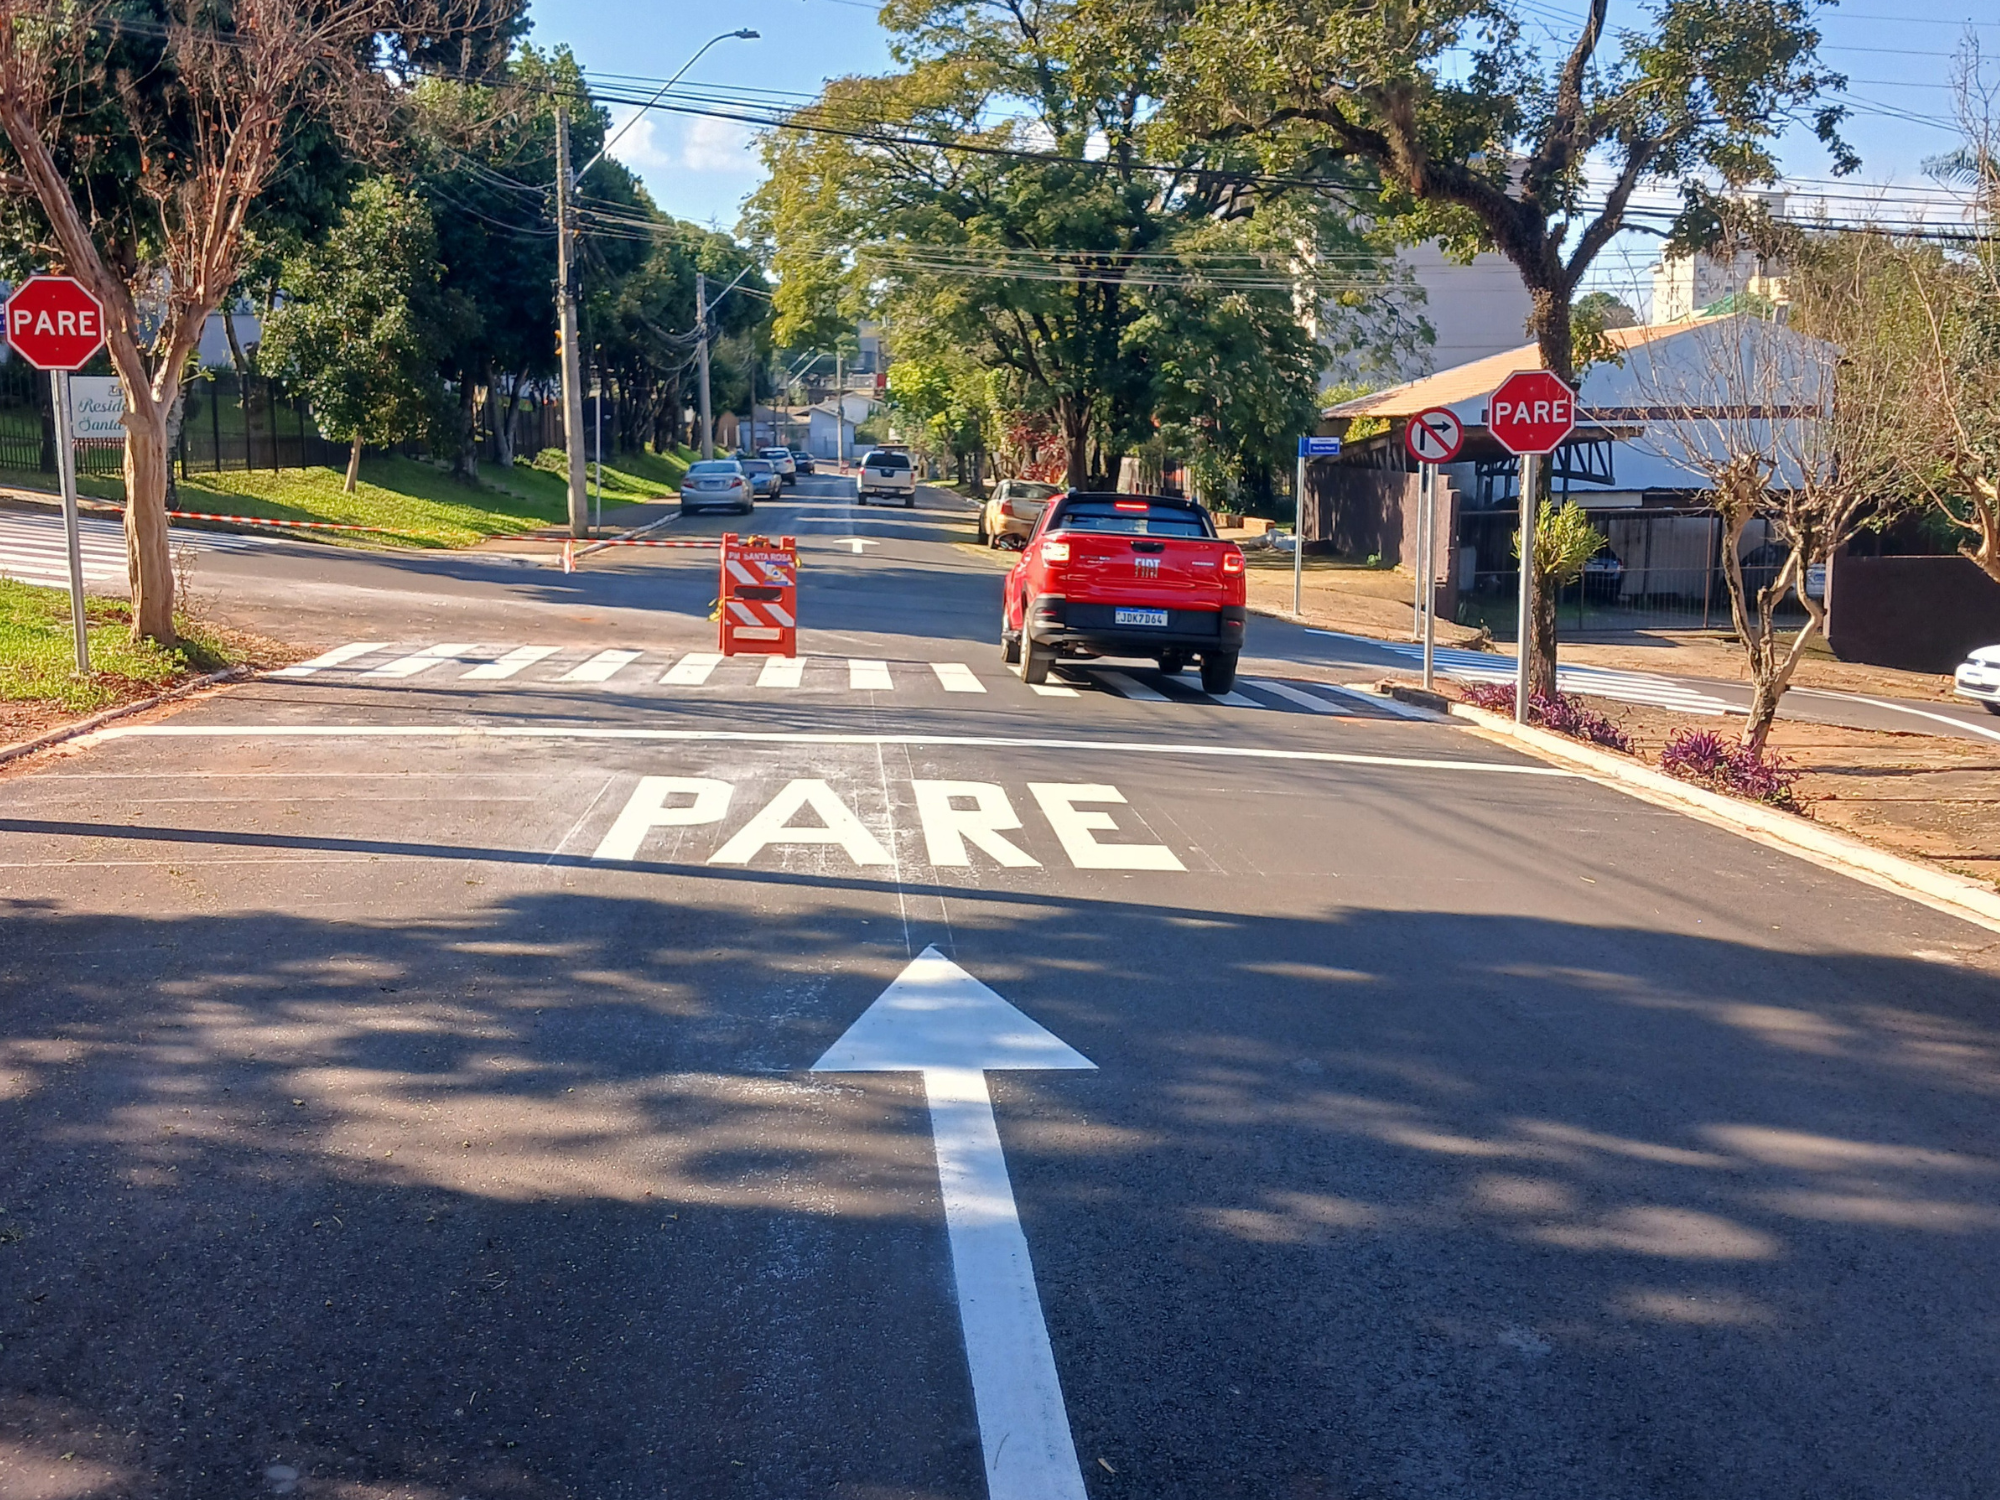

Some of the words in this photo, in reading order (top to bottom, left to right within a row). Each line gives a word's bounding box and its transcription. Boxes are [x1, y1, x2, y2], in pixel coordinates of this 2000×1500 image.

[14, 310, 97, 336] PARE
[1495, 400, 1568, 425] PARE
[770, 553, 793, 561] ROSA
[1134, 557, 1161, 579] FIAT
[1121, 612, 1162, 624] JDK7D64
[590, 775, 1189, 872] PARE
